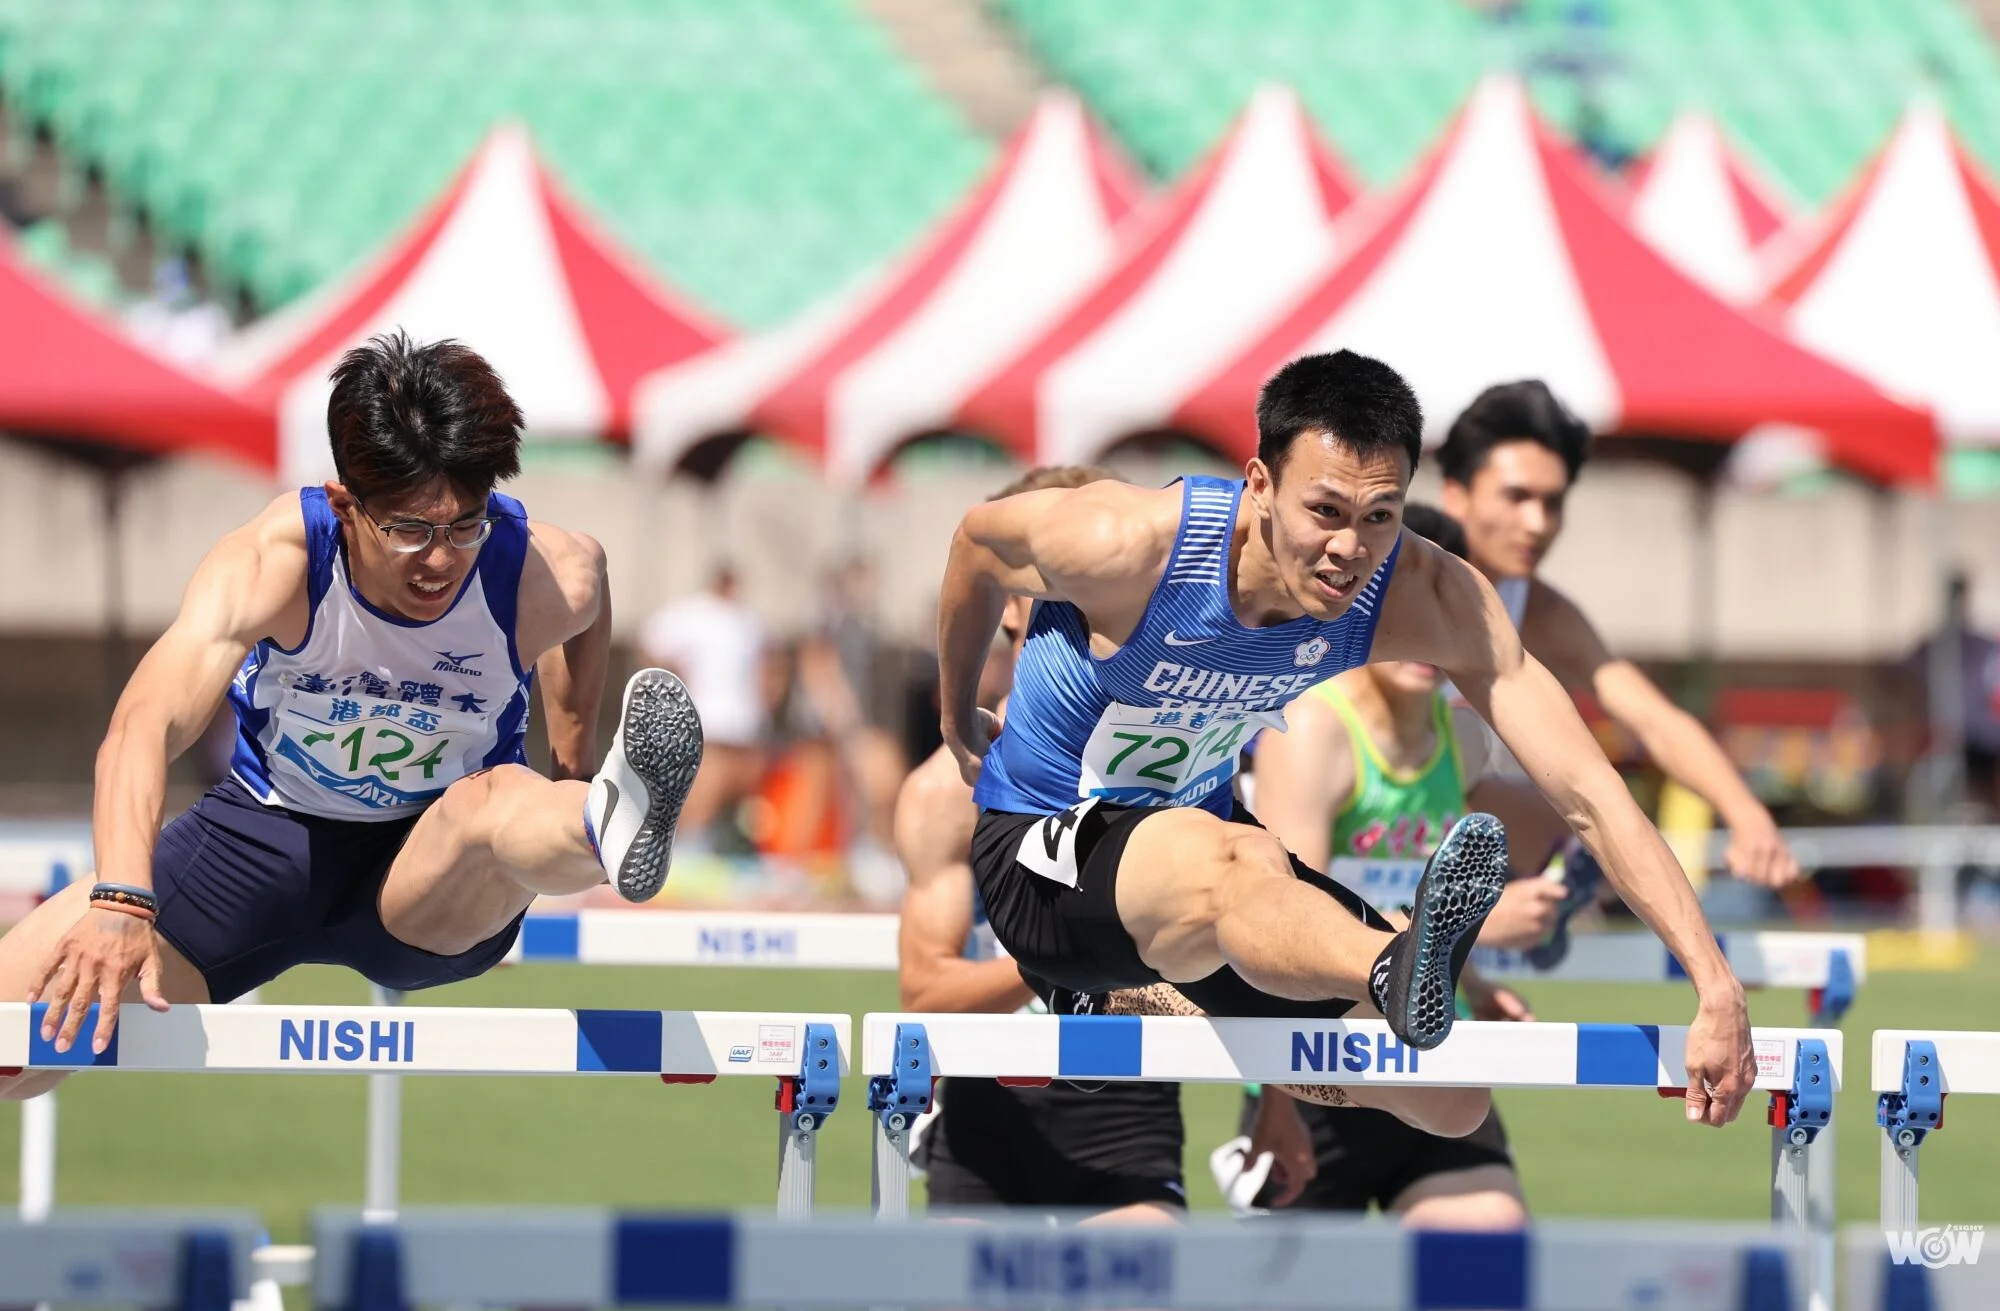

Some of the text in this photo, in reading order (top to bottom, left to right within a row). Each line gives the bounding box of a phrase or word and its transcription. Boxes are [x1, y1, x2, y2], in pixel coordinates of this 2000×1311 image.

[1143, 661, 1317, 700] CHINESE
[697, 928, 797, 955] NISHI
[279, 1019, 415, 1063] NISHI
[1291, 1031, 1418, 1073] NISHI
